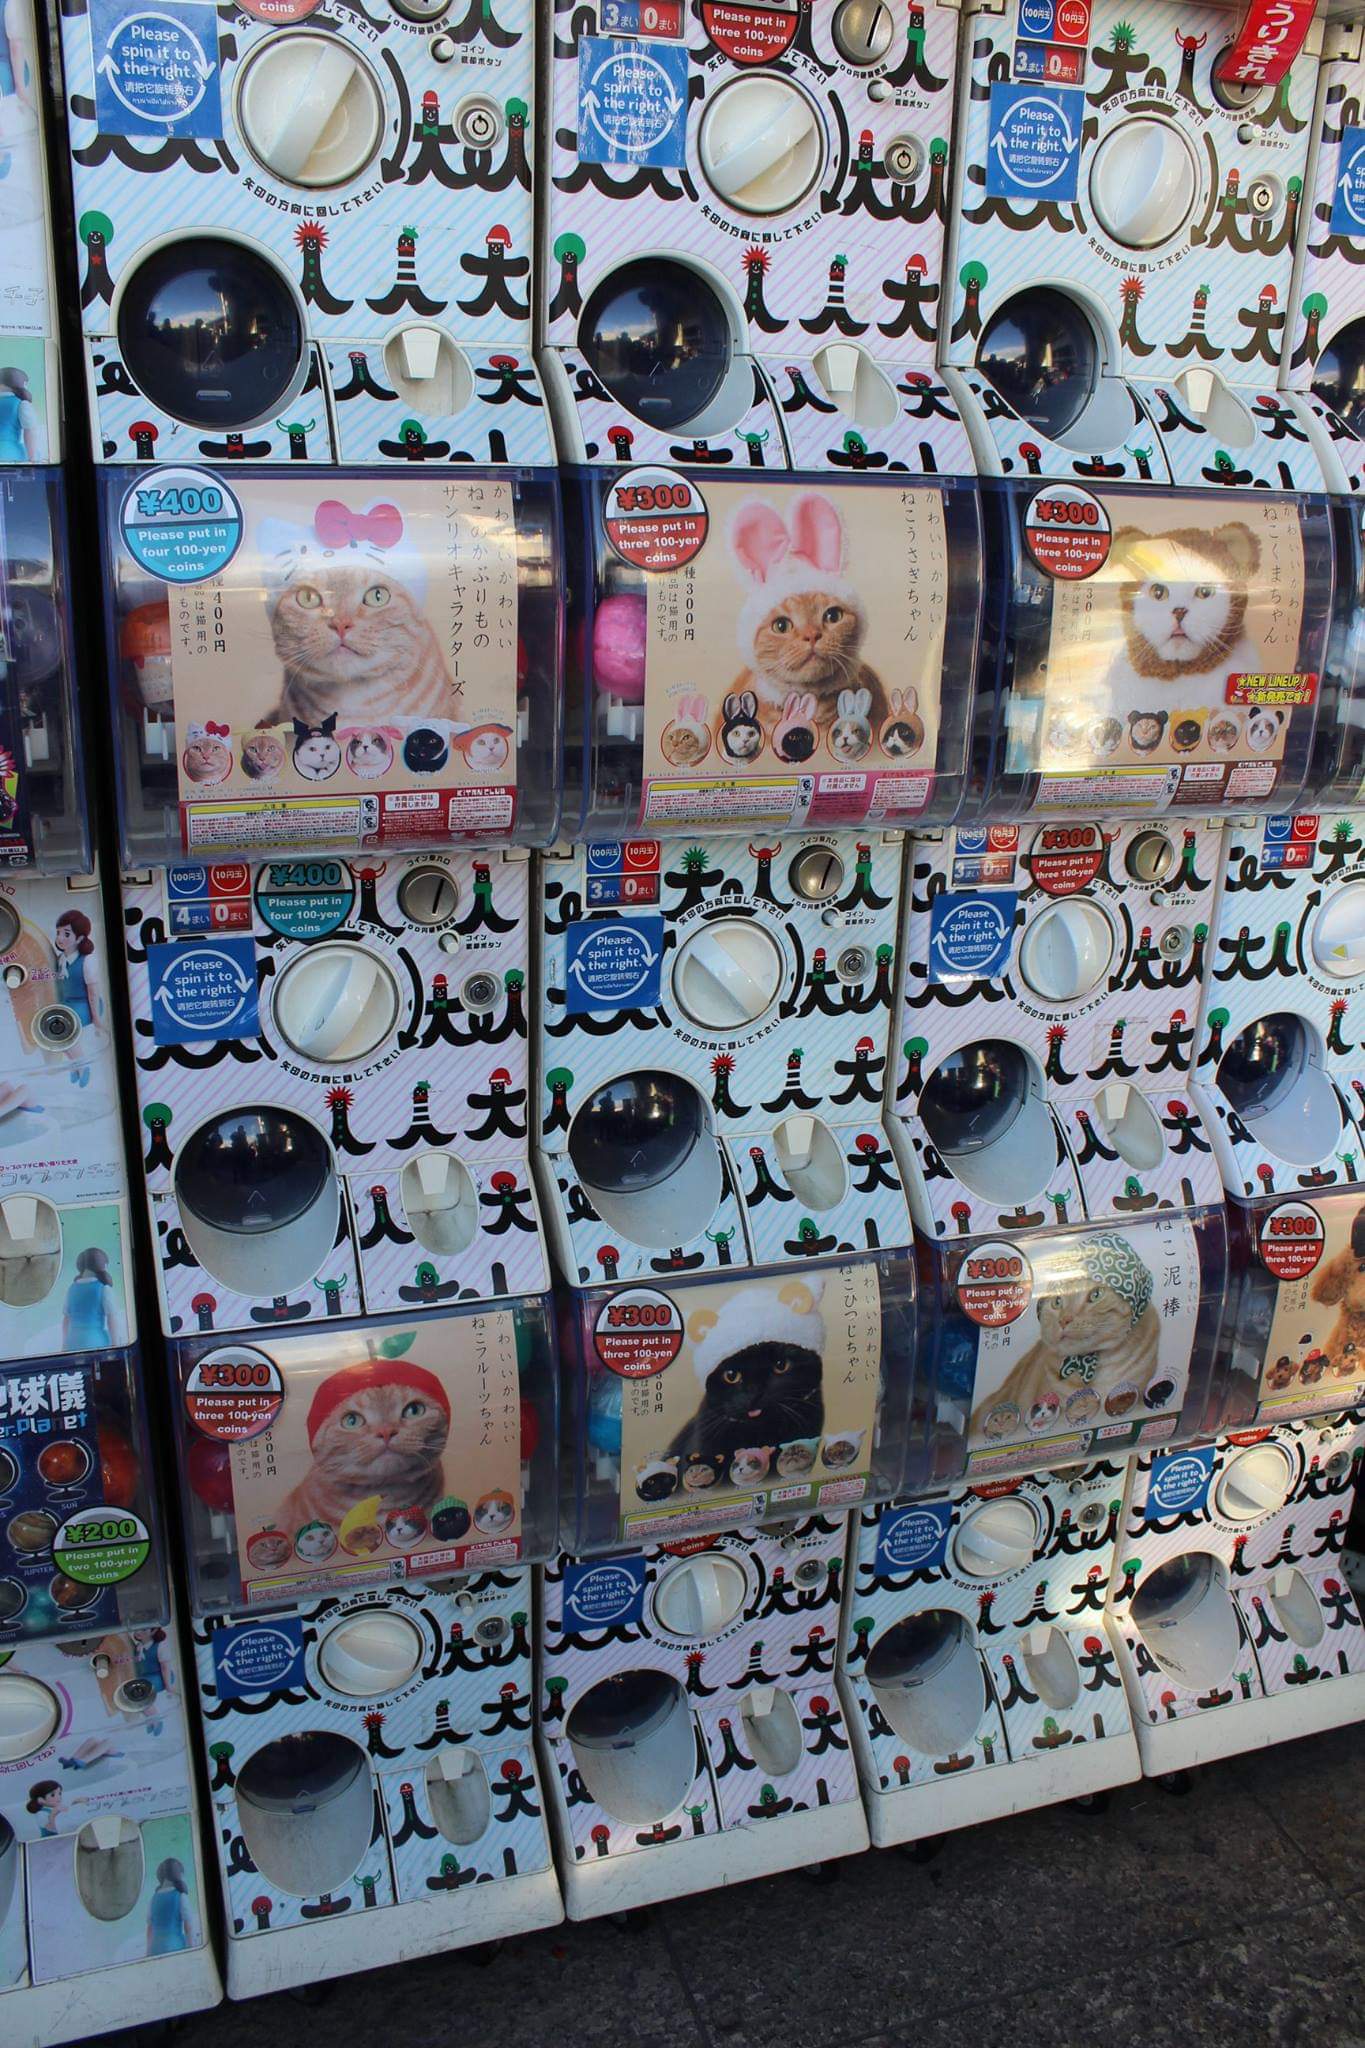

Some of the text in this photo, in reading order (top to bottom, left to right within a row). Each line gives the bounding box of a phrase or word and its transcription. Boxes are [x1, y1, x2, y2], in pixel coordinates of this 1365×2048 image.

[260, 1, 295, 14] coins
[713, 9, 786, 28] Please put in
[131, 26, 180, 42] Please
[711, 25, 787, 44] three 100-yen
[1235, 3, 1295, 80] うりきれ
[122, 44, 190, 60] spin it to
[734, 45, 763, 57] coins
[124, 61, 196, 80] the right.
[1020, 107, 1054, 122] Please
[1011, 124, 1061, 137] spin it to
[1010, 137, 1061, 154] the right.
[242, 177, 384, 217] 矢印の方向に回して下さい
[136, 487, 223, 516] ¥400
[615, 484, 691, 511] ¥300
[1035, 499, 1099, 525] ¥300
[620, 521, 695, 533] Please put in
[139, 528, 226, 541] Please put in
[1036, 533, 1100, 546] Please put in
[618, 537, 699, 549] three 100-yen
[142, 545, 226, 557] four 100-yen
[646, 552, 677, 562] coins
[1035, 548, 1102, 560] three 100-yen
[168, 562, 204, 572] coins
[901, 491, 921, 641] ねこうさぎちゃん
[926, 492, 943, 640] かわいいかわいい
[1056, 563, 1082, 572] coins
[1264, 505, 1283, 644] ねこくまちゃん
[443, 486, 466, 696] サンリオキャラクターズ
[1247, 674, 1266, 688] NEW
[1042, 827, 1096, 849] ¥300
[1039, 858, 1067, 867] Please
[1069, 858, 1083, 867] put
[270, 863, 342, 886] ¥400
[1036, 868, 1094, 879] three 100-yen
[1052, 881, 1075, 890] coins
[268, 896, 342, 907] Please put in
[270, 910, 340, 921] four 100-yen
[958, 910, 989, 919] Please
[290, 923, 321, 933] coins
[950, 920, 995, 932] spin it to
[597, 936, 633, 946] Please
[949, 931, 996, 942] the right.
[588, 947, 640, 960] spin it to
[183, 960, 223, 971] Please
[588, 959, 642, 971] the right.
[175, 972, 232, 987] spin it to
[175, 985, 236, 998] the right.
[1270, 1216, 1316, 1235] ¥300
[967, 1257, 1022, 1279] ¥300
[998, 1286, 1013, 1296] put
[608, 1304, 672, 1327] ¥300
[606, 1338, 639, 1346] Please
[642, 1338, 659, 1346] put
[633, 1350, 672, 1359] 100-yen
[624, 1362, 651, 1370] coins
[199, 1364, 270, 1386] ¥300
[472, 1317, 494, 1446] ねこフルーツちゃん
[197, 1398, 270, 1407] Please put in
[195, 1411, 271, 1421] three 100-yen
[217, 1425, 248, 1433] coins
[61, 1502, 78, 1510] SUN
[65, 1519, 137, 1543] ¥200
[66, 1551, 103, 1561] Please
[107, 1548, 125, 1559] put
[68, 1558, 137, 1571] two 100-yen
[89, 1572, 119, 1581] coins
[589, 1573, 620, 1583] Please
[582, 1584, 599, 1593] spin
[601, 1582, 608, 1590] it
[582, 1590, 629, 1602] the right.
[241, 1636, 275, 1646] Please
[235, 1648, 256, 1657] spin
[236, 1653, 286, 1665] the right.
